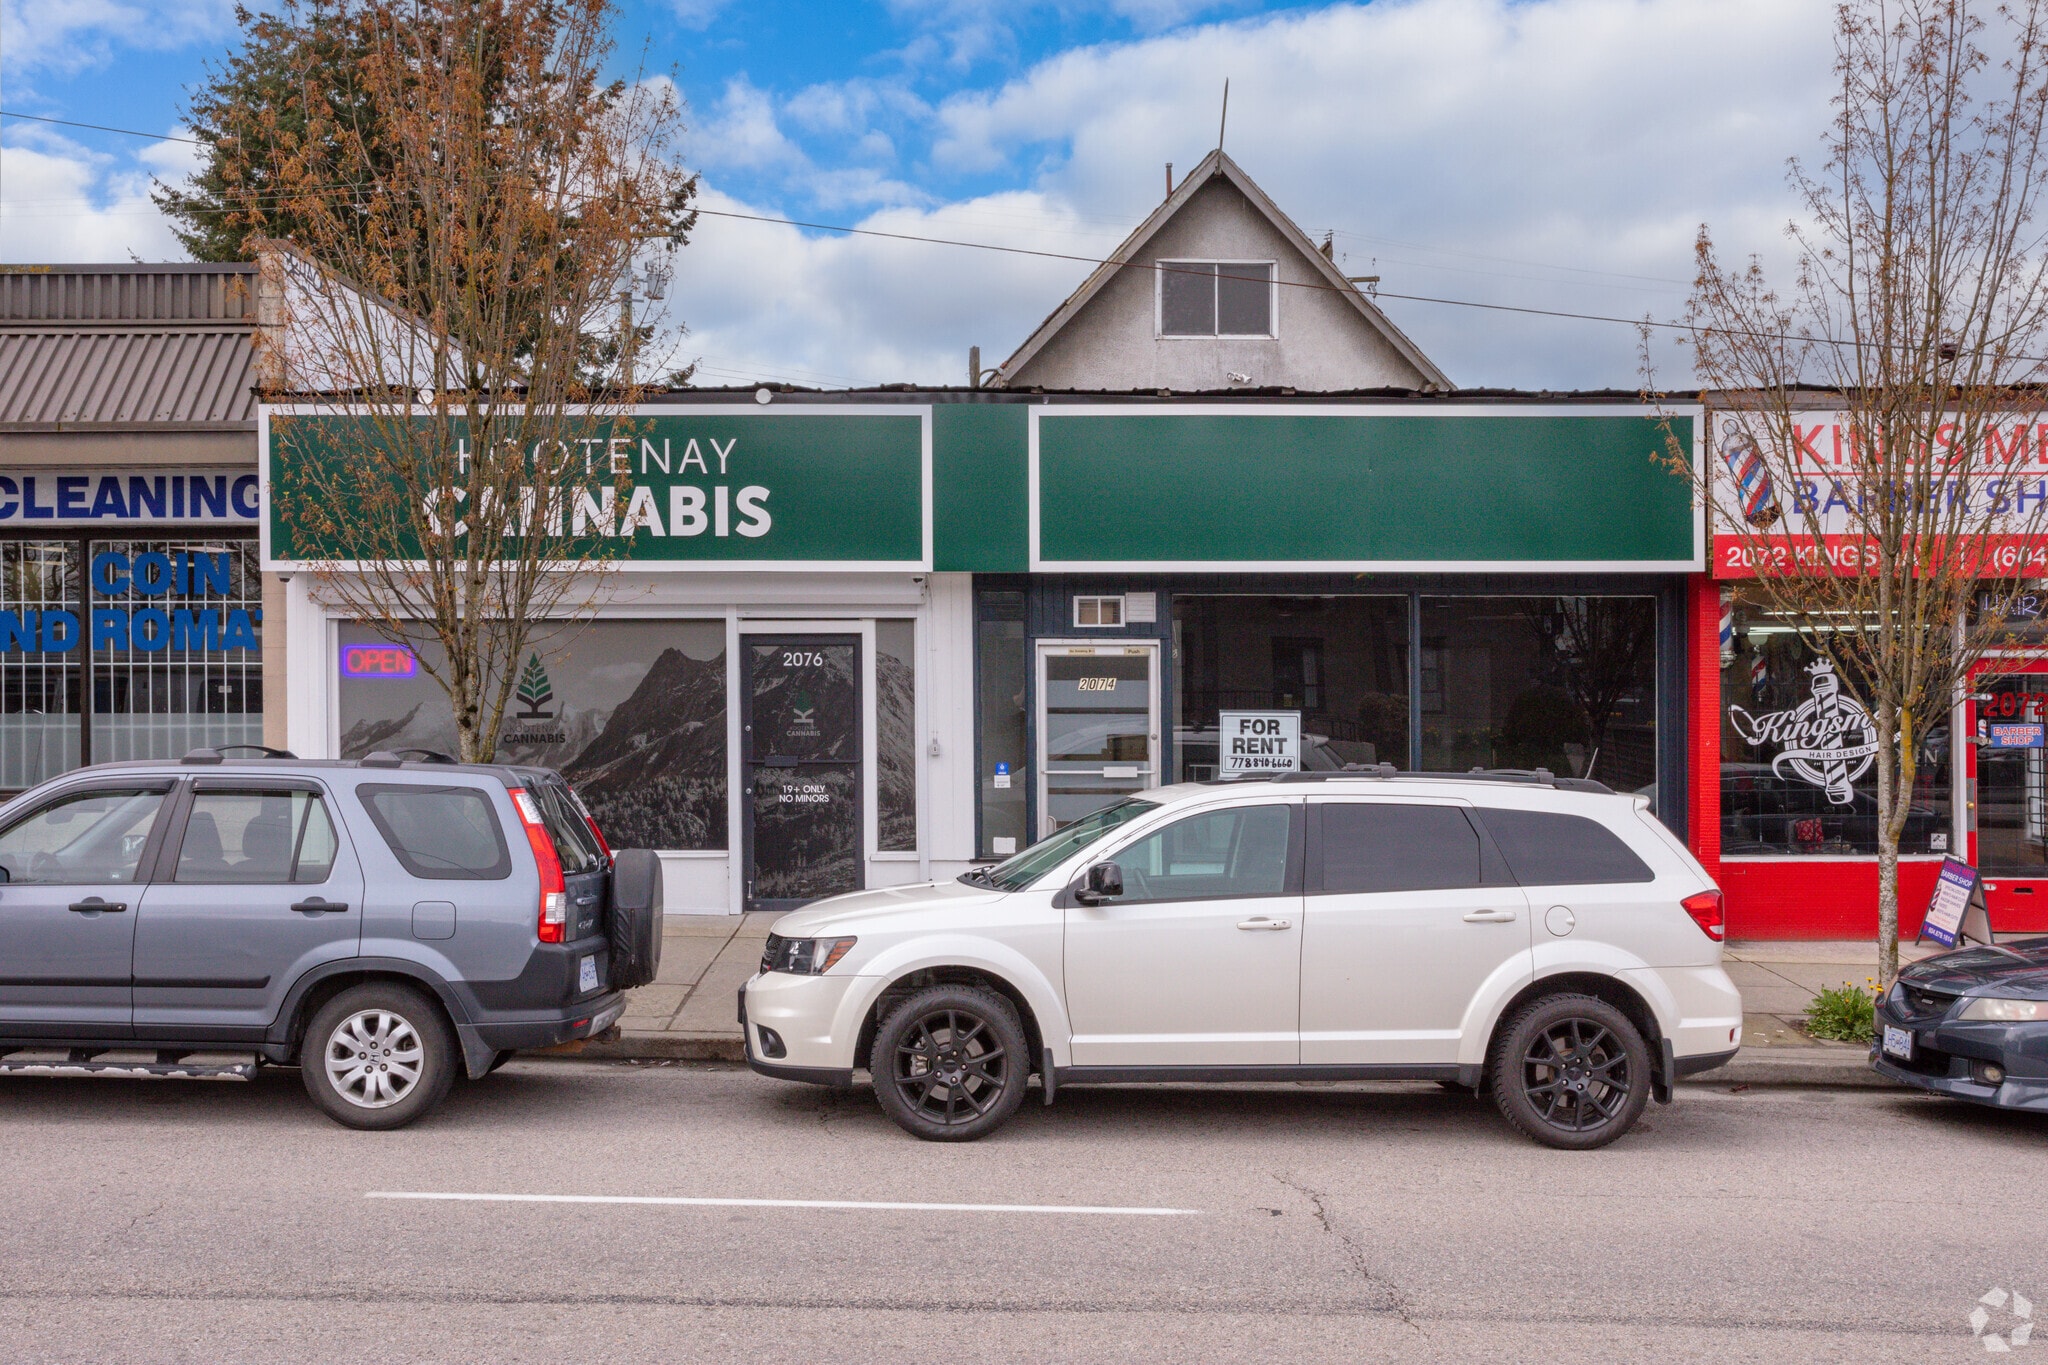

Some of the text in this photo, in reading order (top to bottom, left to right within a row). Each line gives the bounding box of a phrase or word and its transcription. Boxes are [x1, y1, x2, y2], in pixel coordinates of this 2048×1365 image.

[1726, 546, 1786, 568] 2072
[1795, 545, 1932, 568] KINGS
[92, 551, 231, 595] COIN
[346, 648, 413, 674] OPEN
[783, 652, 823, 667] 2076
[1079, 678, 1116, 690] 2074
[1983, 692, 2048, 717] 2072
[1239, 718, 1281, 735] FOR
[1752, 707, 1914, 749] Kingsm
[1993, 726, 2042, 736] BARBER
[503, 733, 566, 744] CANNABIS
[1232, 737, 1288, 755] RENT
[2001, 735, 2034, 745] SHOP
[1809, 746, 1872, 759] HAIR DESIGN
[782, 785, 826, 793] 19+ ONLY
[779, 795, 830, 803] NO MINORS
[1941, 869, 1973, 888] BARBER SHOP
